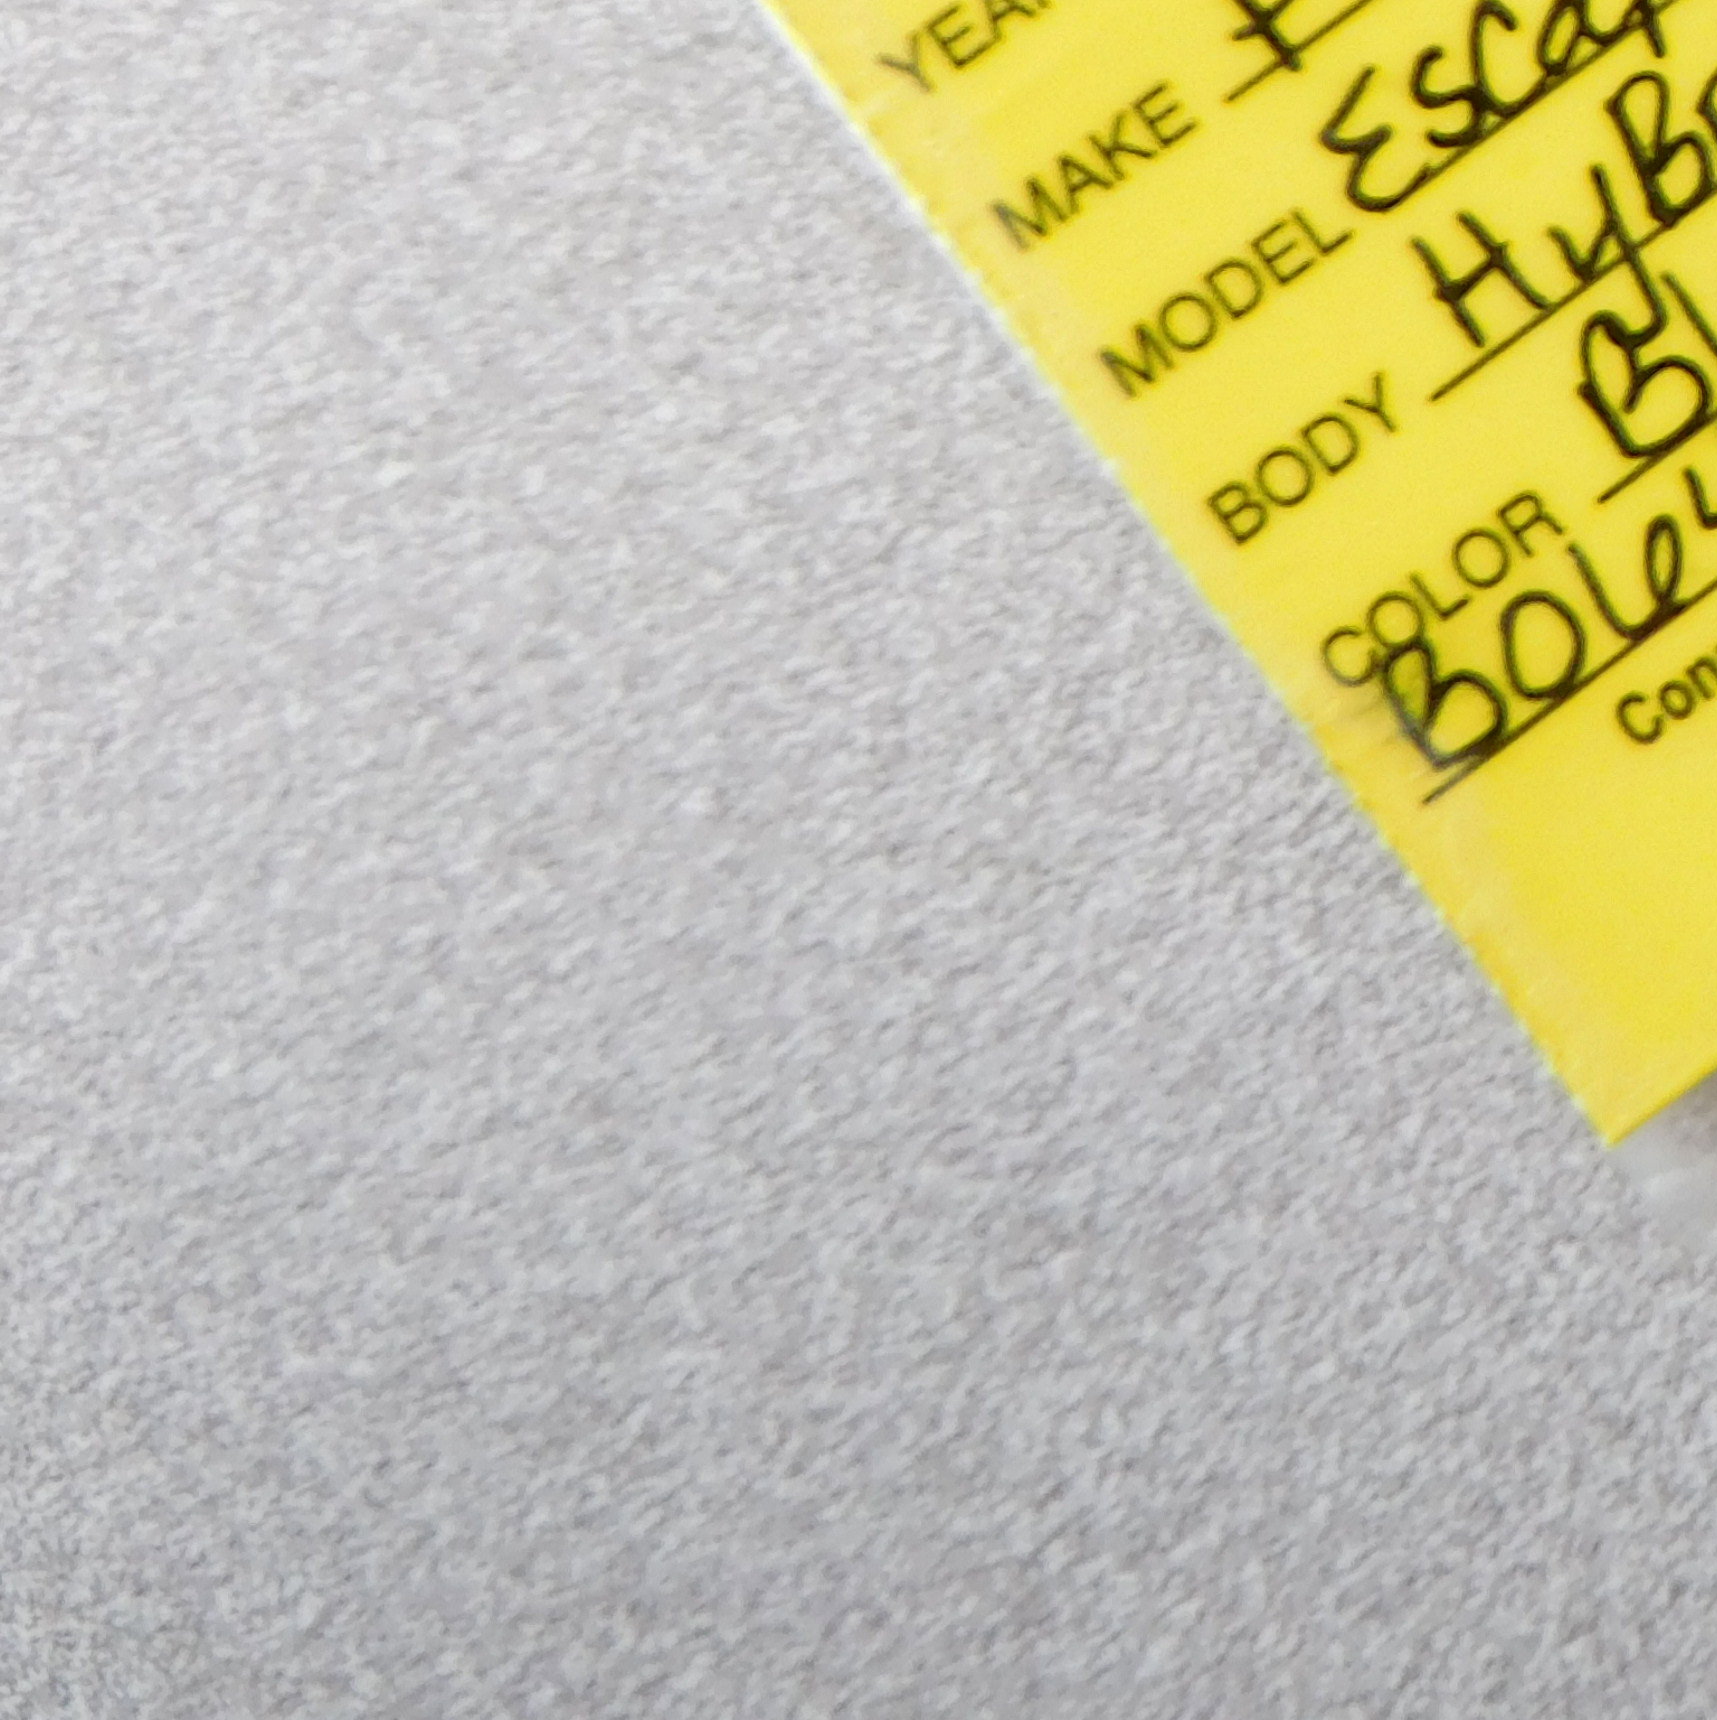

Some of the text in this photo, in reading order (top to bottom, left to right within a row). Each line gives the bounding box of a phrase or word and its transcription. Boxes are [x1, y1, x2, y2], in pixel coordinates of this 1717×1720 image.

[988, 82, 1199, 252] MAKE
[1100, 205, 1354, 399] MODEL
[1205, 370, 1403, 548] BODY
[1318, 488, 1566, 692] COLOR
